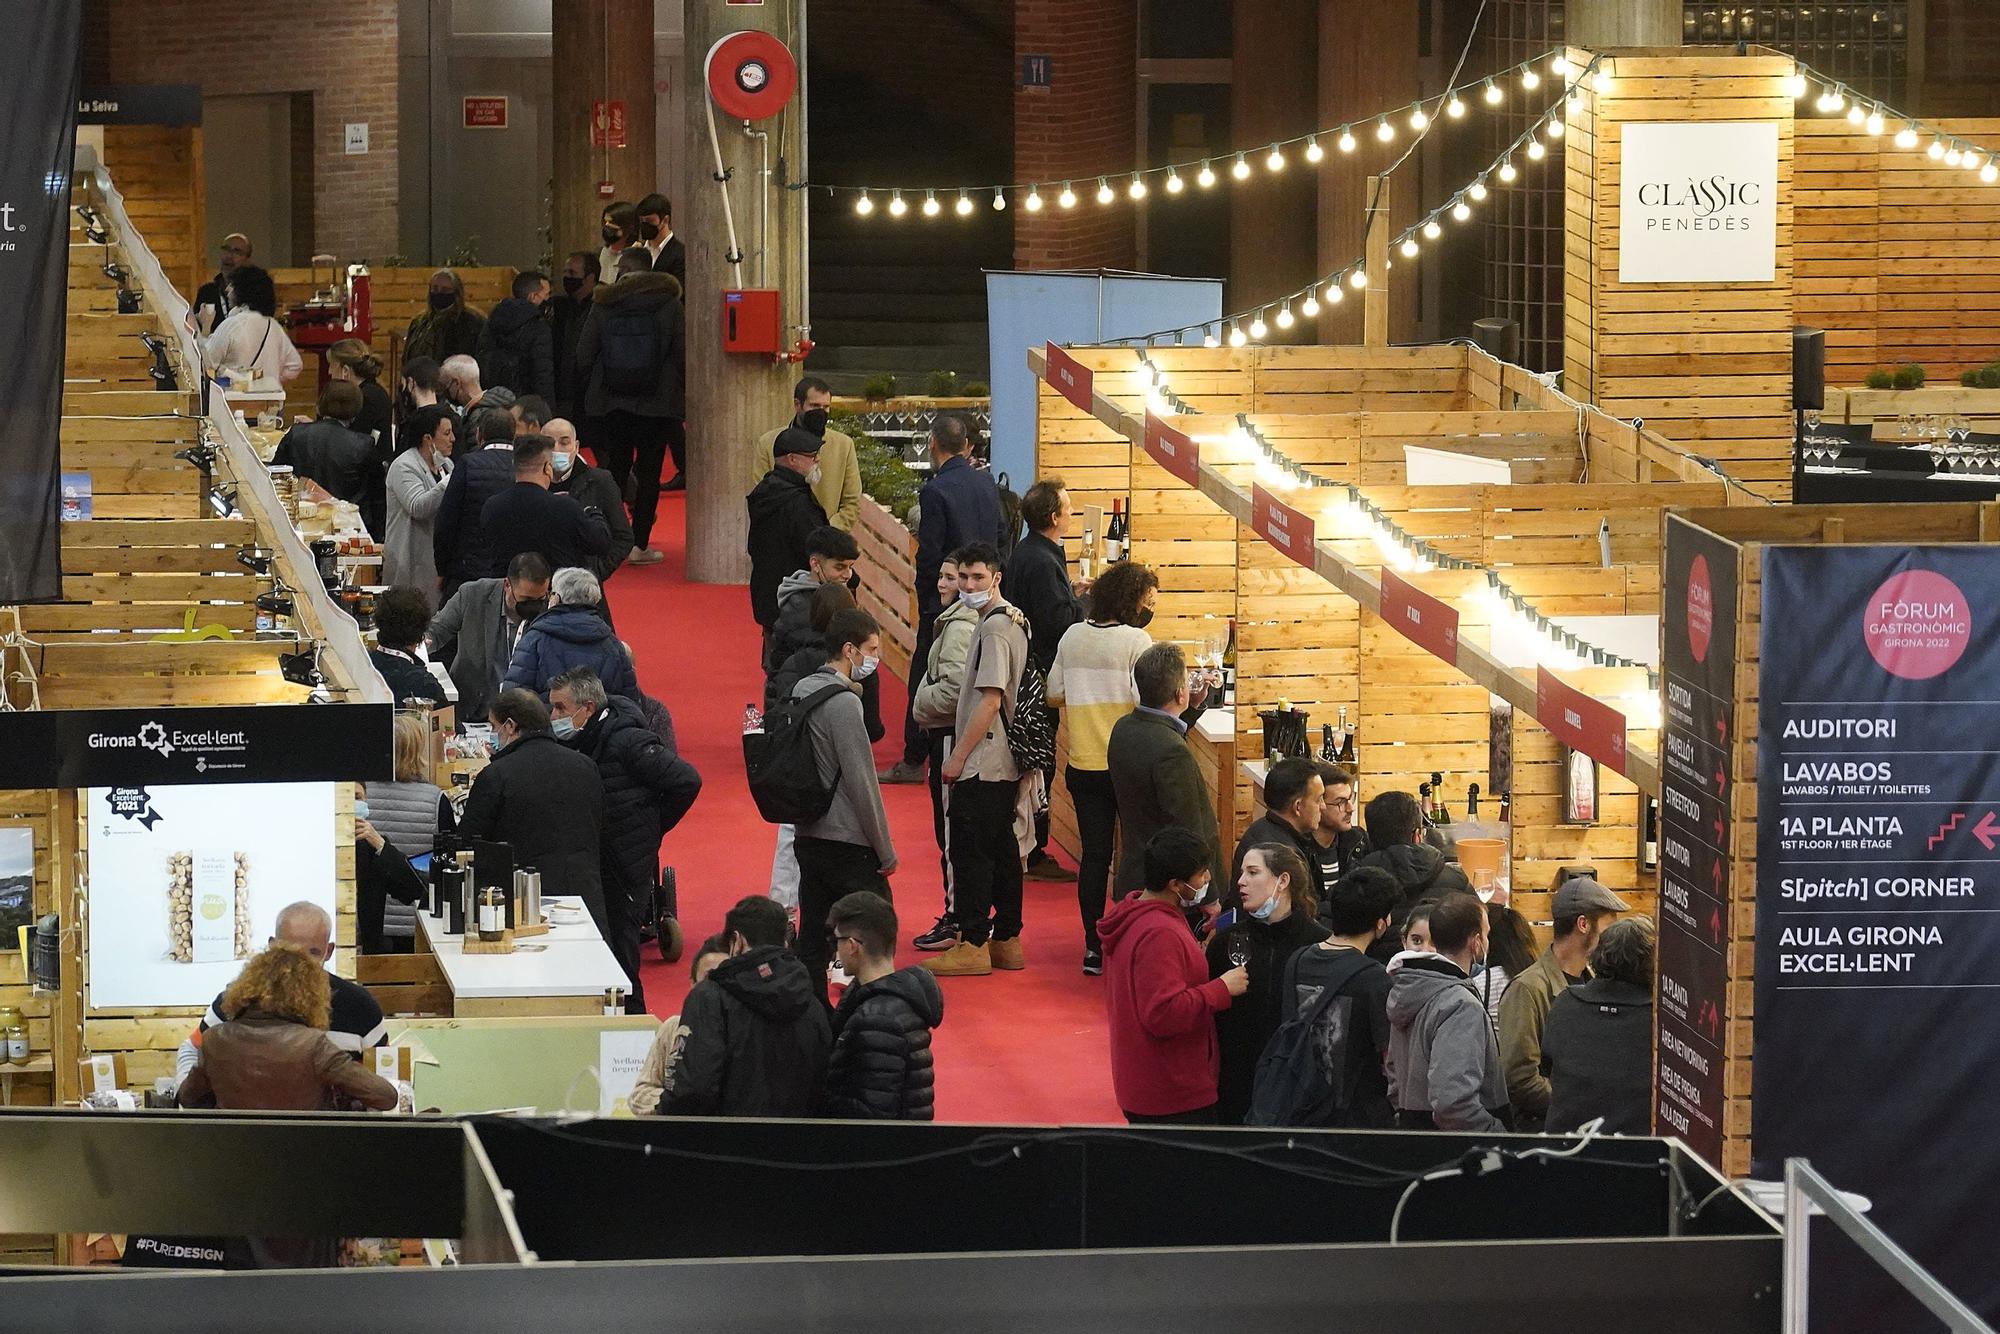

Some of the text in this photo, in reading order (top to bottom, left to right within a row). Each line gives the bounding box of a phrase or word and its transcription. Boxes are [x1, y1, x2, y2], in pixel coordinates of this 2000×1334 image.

[78, 99, 118, 112] La Selva
[1638, 174, 1760, 217] CLÀSSIC
[1647, 215, 1750, 231] PENEDÈS
[1881, 599, 1954, 619] FÒRUM
[1869, 620, 1966, 635] GASTRONÒMIC
[1884, 638, 1950, 648] GIRONA 2022
[1668, 682, 1692, 711] SORTIDA
[1782, 718, 1897, 739] AUDITORI
[88, 734, 137, 748] Girona
[1667, 733, 1694, 764] PAVELLÓ 1
[1783, 762, 1892, 782] LAVABOS
[1782, 785, 1829, 795] LAVABOS
[1837, 785, 1871, 795] TOILET
[1879, 784, 1931, 794] TOILETTES
[116, 801, 139, 811] 2021
[1665, 786, 1700, 821] STREETFOOD
[1779, 816, 1904, 836] 1A PLANTA
[1665, 837, 1690, 867] AUDITORI
[1780, 840, 1798, 849] 1ST
[1799, 840, 1833, 849] FLOOR
[1840, 840, 1859, 849] 1ER
[1860, 838, 1892, 849] ÉTAGE
[1664, 877, 1689, 909] LAVABOS
[1780, 877, 1975, 902] S[pitch] CORNER
[1779, 926, 1943, 946] AULA GIRONA
[1779, 953, 1916, 973] EXCEL·LENT
[1669, 978, 1688, 1008] PLANTA
[136, 1238, 225, 1261] #PUREDESIGN
